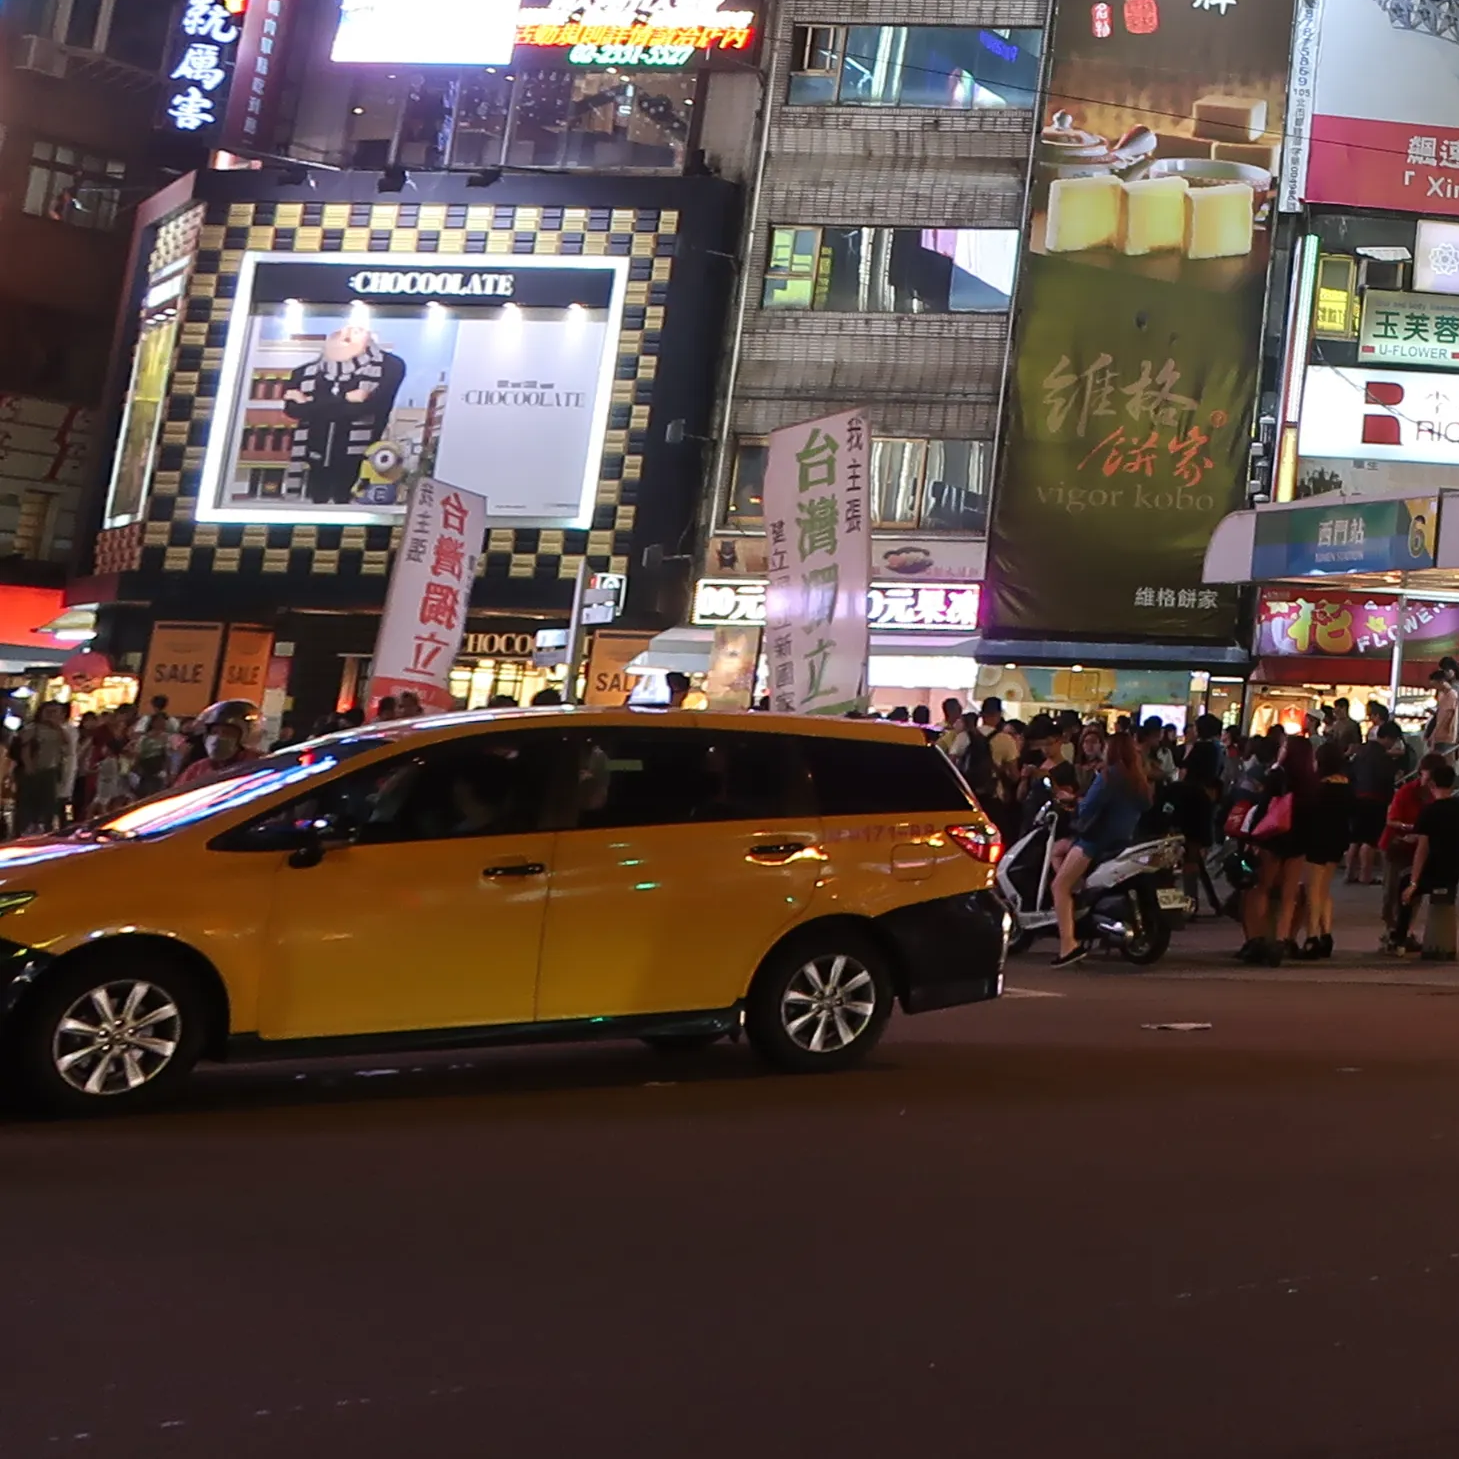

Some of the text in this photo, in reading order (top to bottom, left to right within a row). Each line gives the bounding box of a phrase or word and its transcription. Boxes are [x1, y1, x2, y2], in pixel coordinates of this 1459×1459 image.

[1379, 344, 1449, 360] U-FLOWER
[1041, 352, 1198, 438] 維格
[1076, 424, 1216, 489] 餅家
[1035, 482, 1215, 515] vigor kobo
[1317, 519, 1366, 547] 西門站
[1407, 515, 1427, 559] 6
[1133, 586, 1220, 612] 維格餅家
[155, 662, 205, 685] SALE
[227, 662, 261, 687] SALE
